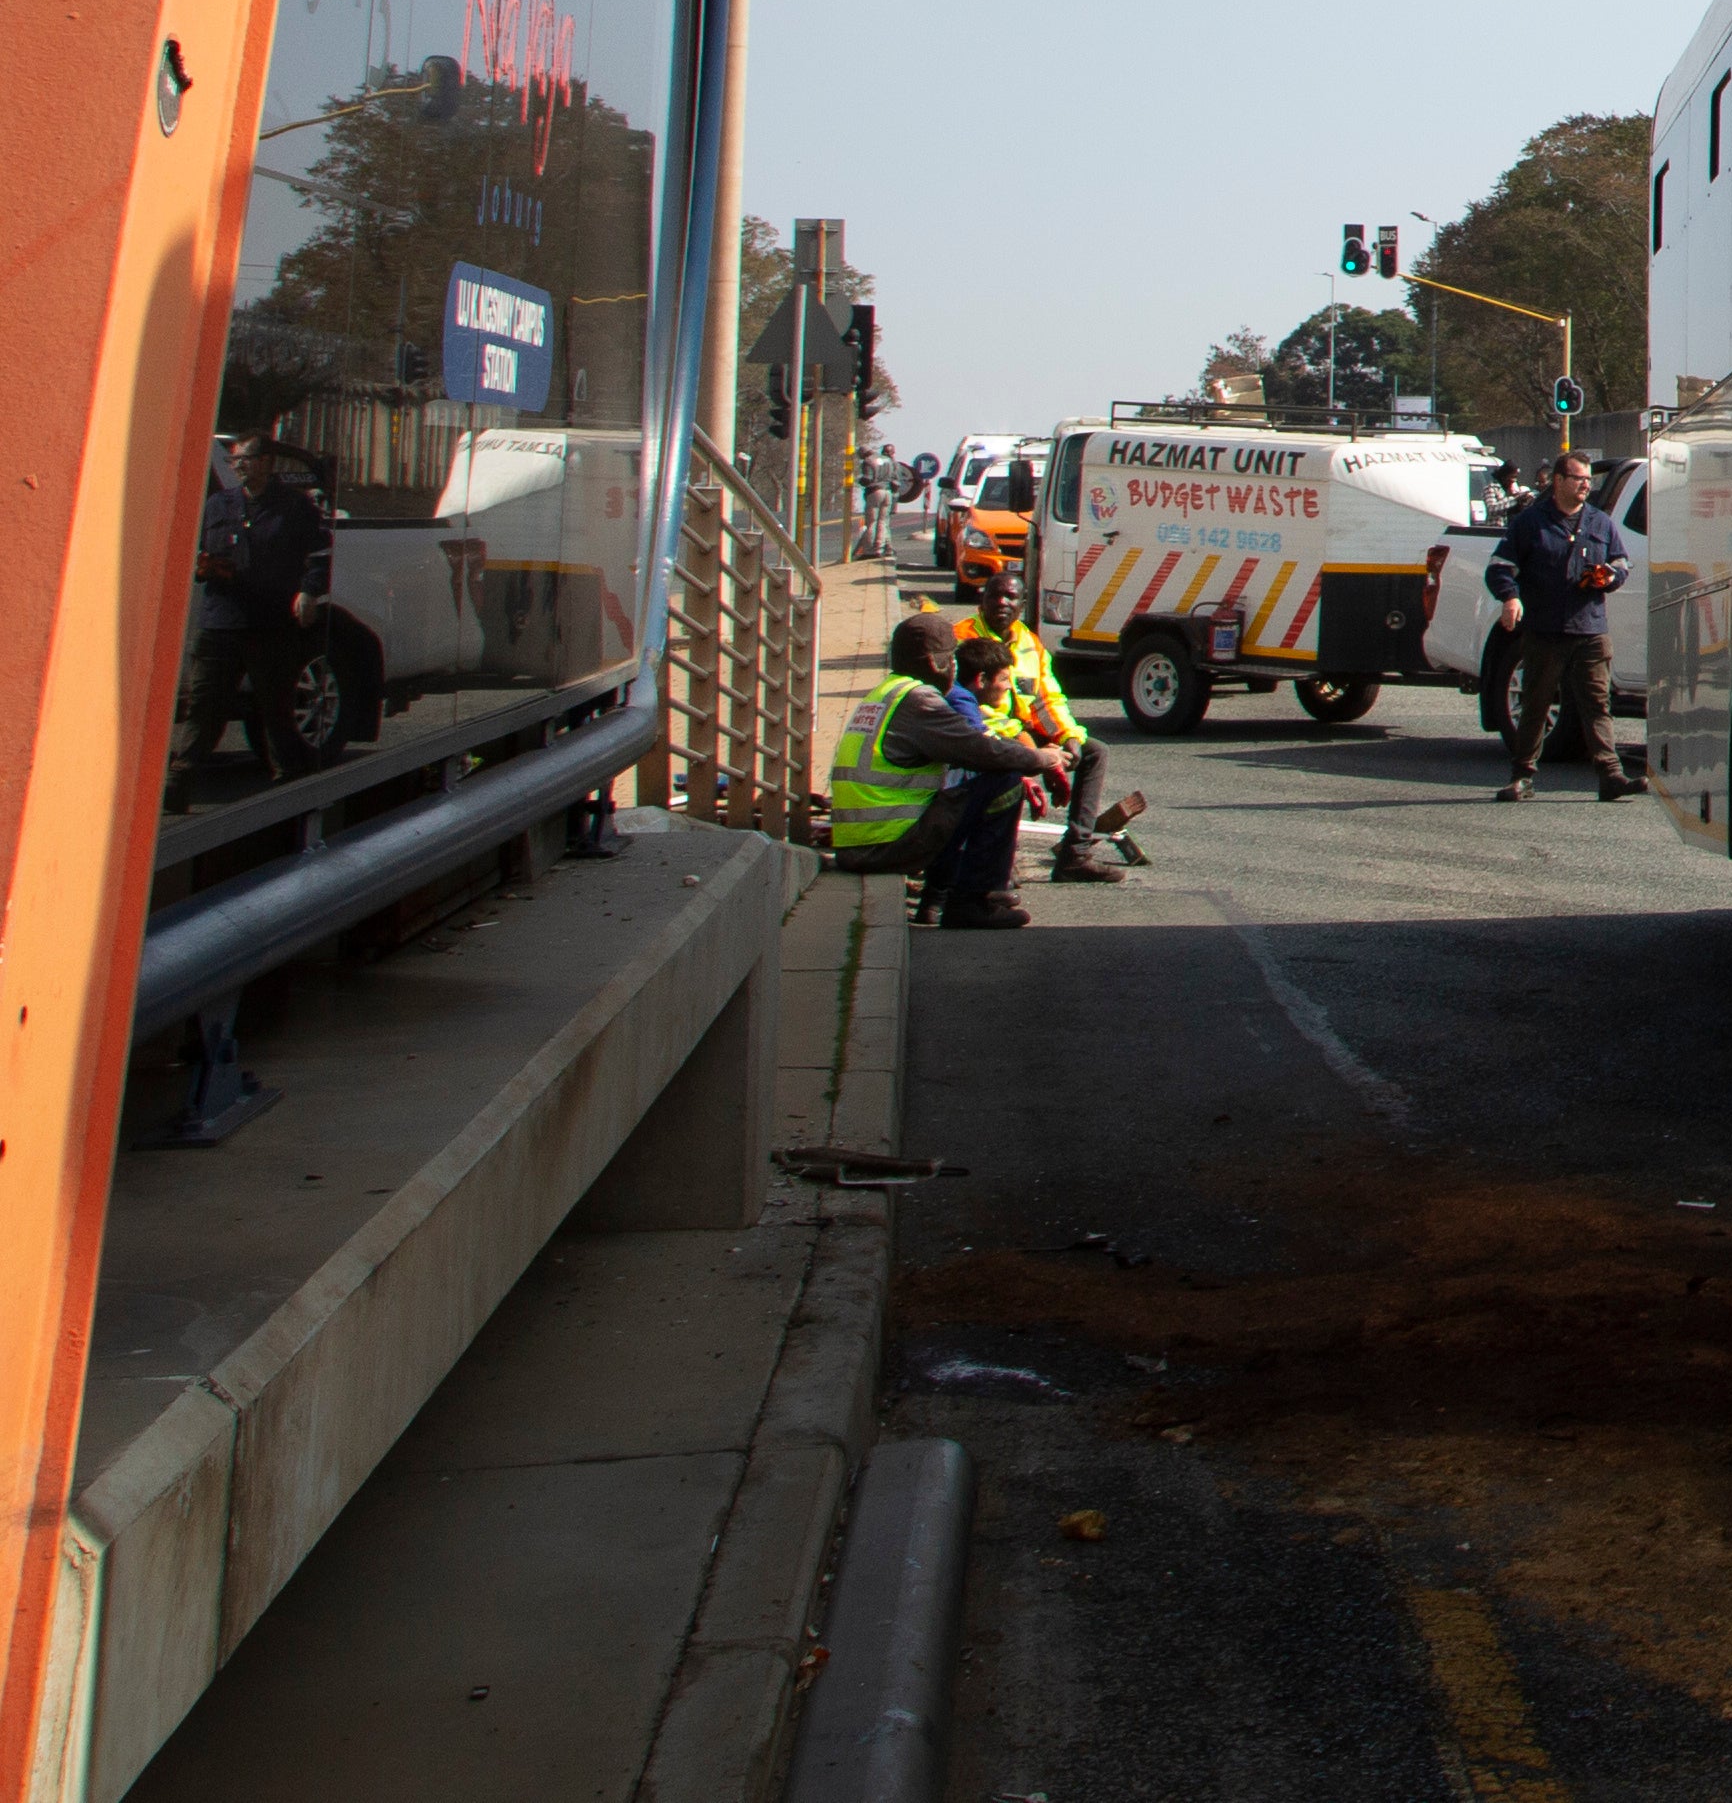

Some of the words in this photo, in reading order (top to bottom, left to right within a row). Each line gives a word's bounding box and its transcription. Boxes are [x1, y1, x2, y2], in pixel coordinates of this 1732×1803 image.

[476, 175, 543, 246] Joburg
[1379, 230, 1397, 241] BUS
[512, 296, 546, 347] CAMPUS
[481, 343, 519, 393] STATION
[1109, 440, 1227, 471] HAZMAT
[1234, 448, 1306, 477] UNIT
[1127, 479, 1220, 518] BUDGET
[1227, 484, 1320, 518] WASTE
[1198, 526, 1229, 548] 142
